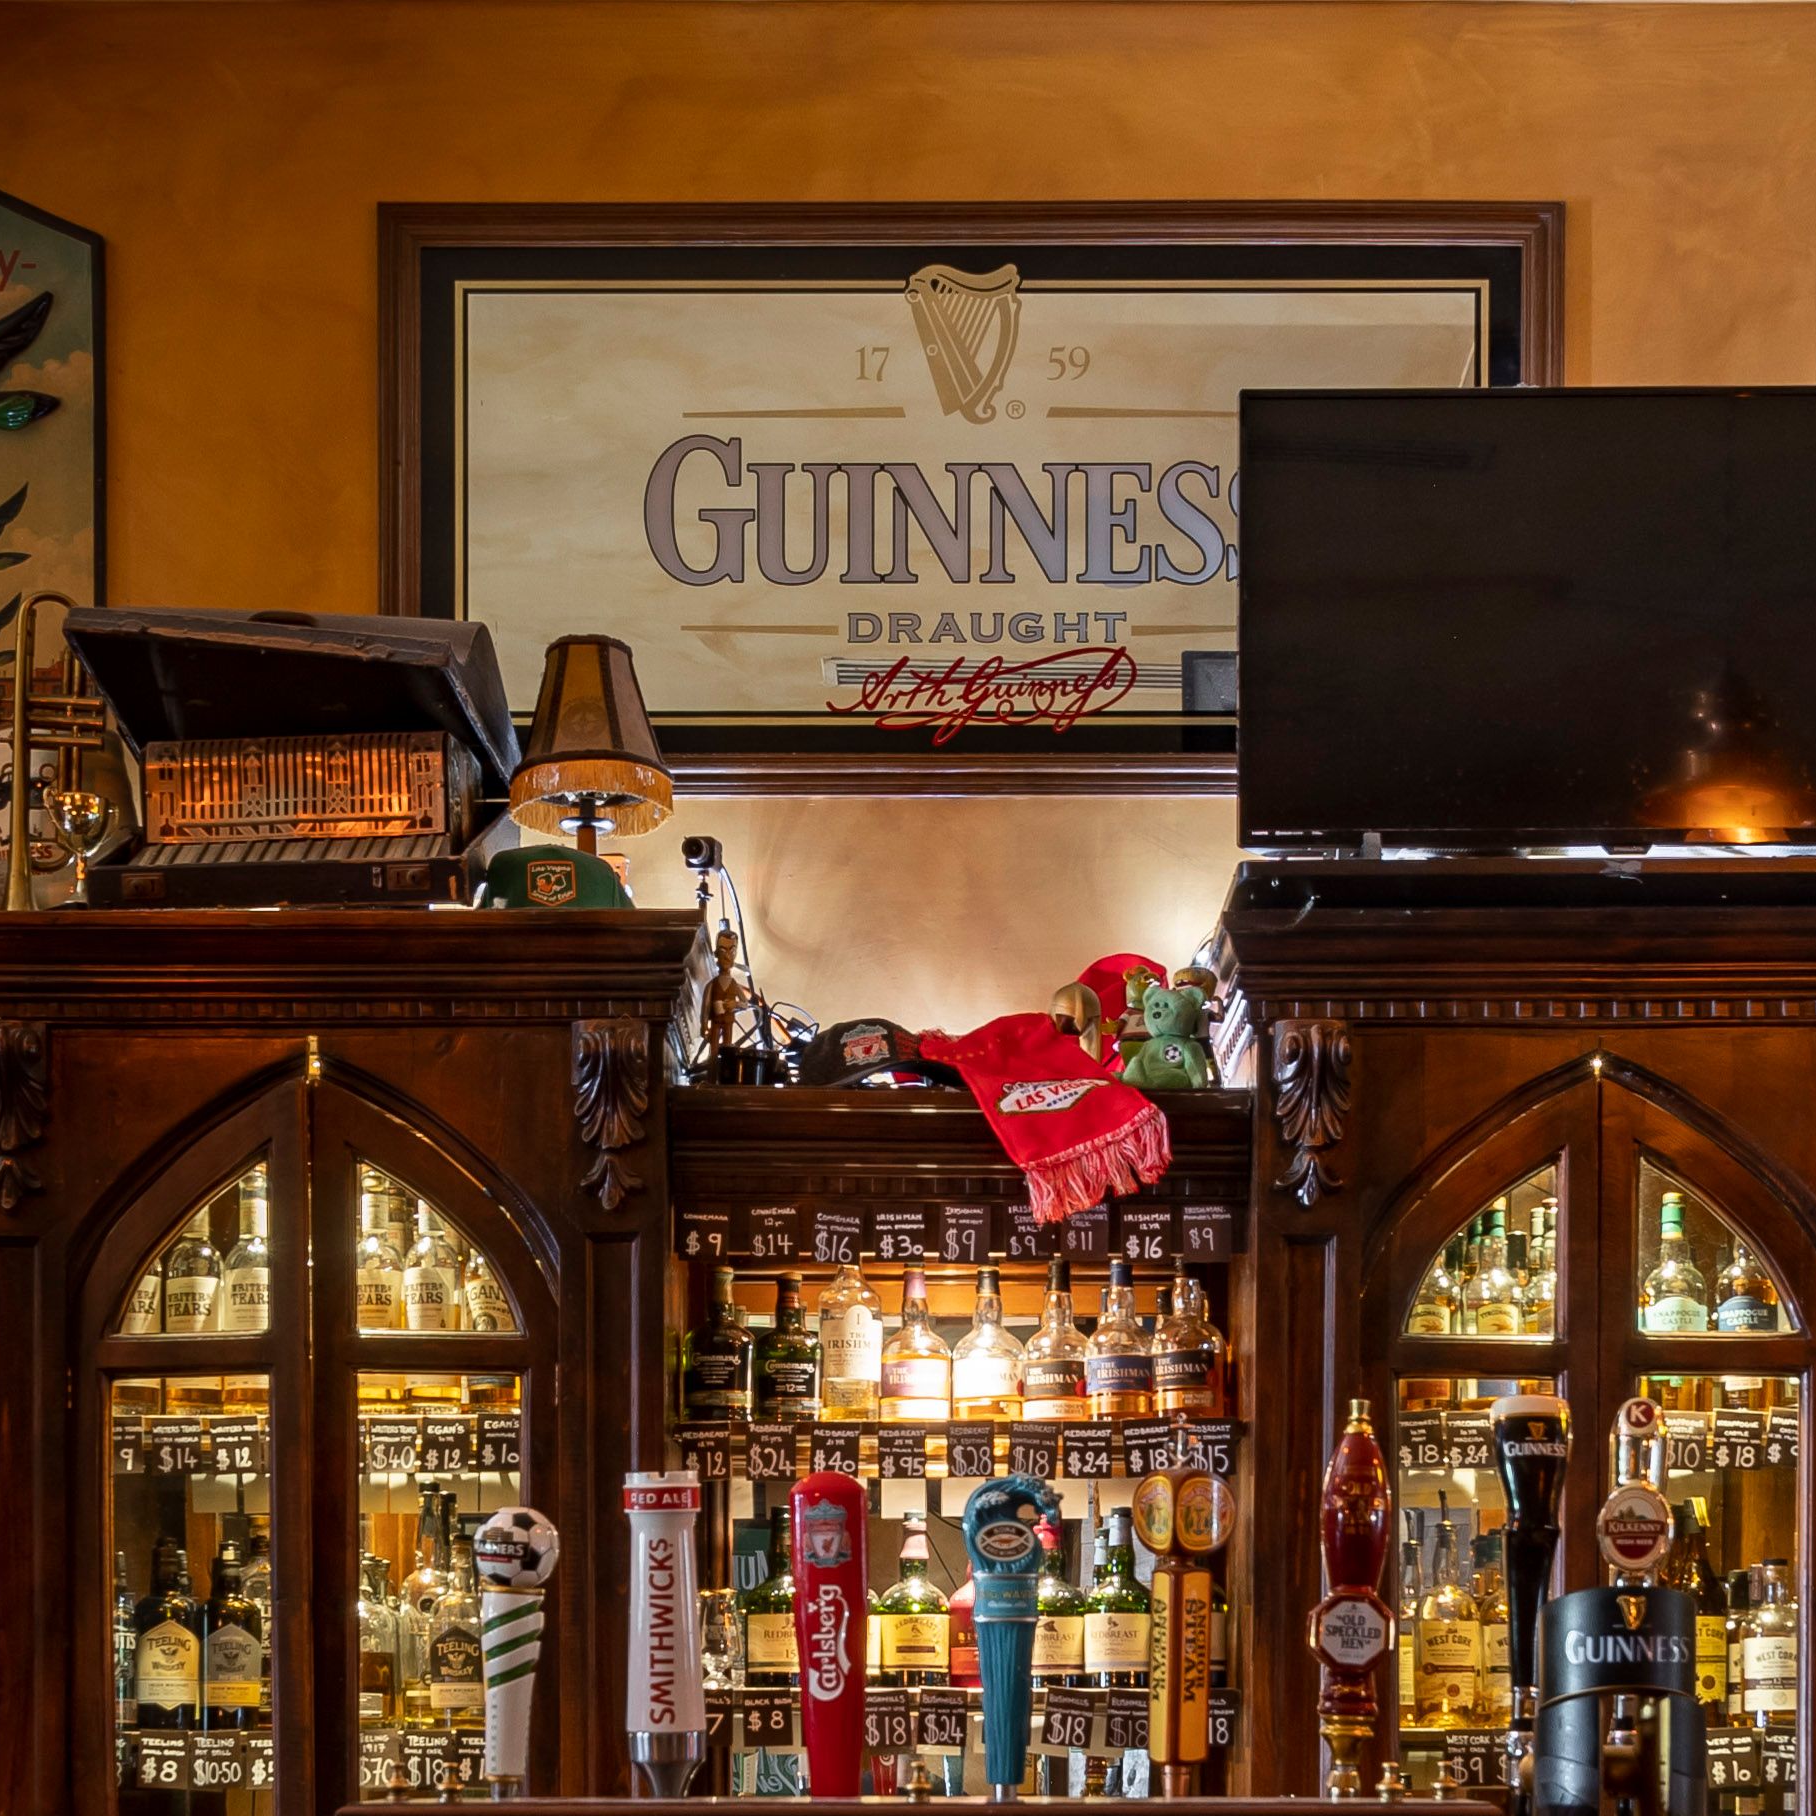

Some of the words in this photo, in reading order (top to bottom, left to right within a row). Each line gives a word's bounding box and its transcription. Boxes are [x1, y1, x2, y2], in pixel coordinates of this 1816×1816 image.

[854, 346, 890, 381] 17
[1048, 346, 1090, 381] 59
[645, 434, 1239, 586] GUINNES
[848, 612, 1127, 644] DRAUGHT
[1015, 1090, 1046, 1110] LAS
[686, 1230, 722, 1257] $9
[752, 1233, 793, 1257] $14
[815, 1231, 852, 1263] $16
[943, 1228, 975, 1261] $9
[404, 1292, 444, 1305] TEARS
[168, 1303, 211, 1317] TEARS
[1630, 1406, 1648, 1422] K
[427, 1422, 465, 1435] EGAN'S
[159, 1445, 198, 1473] $14
[216, 1448, 252, 1470] $12
[372, 1444, 416, 1469] $40
[425, 1449, 462, 1470] $12
[1505, 1441, 1566, 1457] GUINNESS
[1715, 1446, 1754, 1467] $18
[631, 1491, 657, 1505] RED
[662, 1491, 690, 1505] ALE
[1607, 1520, 1663, 1534] KILKENNY
[808, 1584, 851, 1701] Carlsberg
[1325, 1625, 1381, 1638] SPECKLED
[1425, 1636, 1448, 1648] WEST
[1450, 1635, 1471, 1647] CORK
[147, 1636, 191, 1651] TEELING
[212, 1641, 252, 1655] TEELING
[436, 1640, 480, 1657] TEELING
[1184, 1598, 1196, 1703] STEAM
[1196, 1598, 1207, 1689] ANCHOR
[1565, 1630, 1688, 1664] GUINNESS
[1755, 1652, 1776, 1663] WEST
[748, 1710, 784, 1732] $8
[866, 1714, 906, 1746] $18
[924, 1715, 963, 1745] $24
[1047, 1713, 1086, 1744] $18
[194, 1737, 235, 1748] TEELING
[406, 1735, 448, 1747] TEELING
[141, 1756, 178, 1784] $8
[1452, 1757, 1483, 1784] $9
